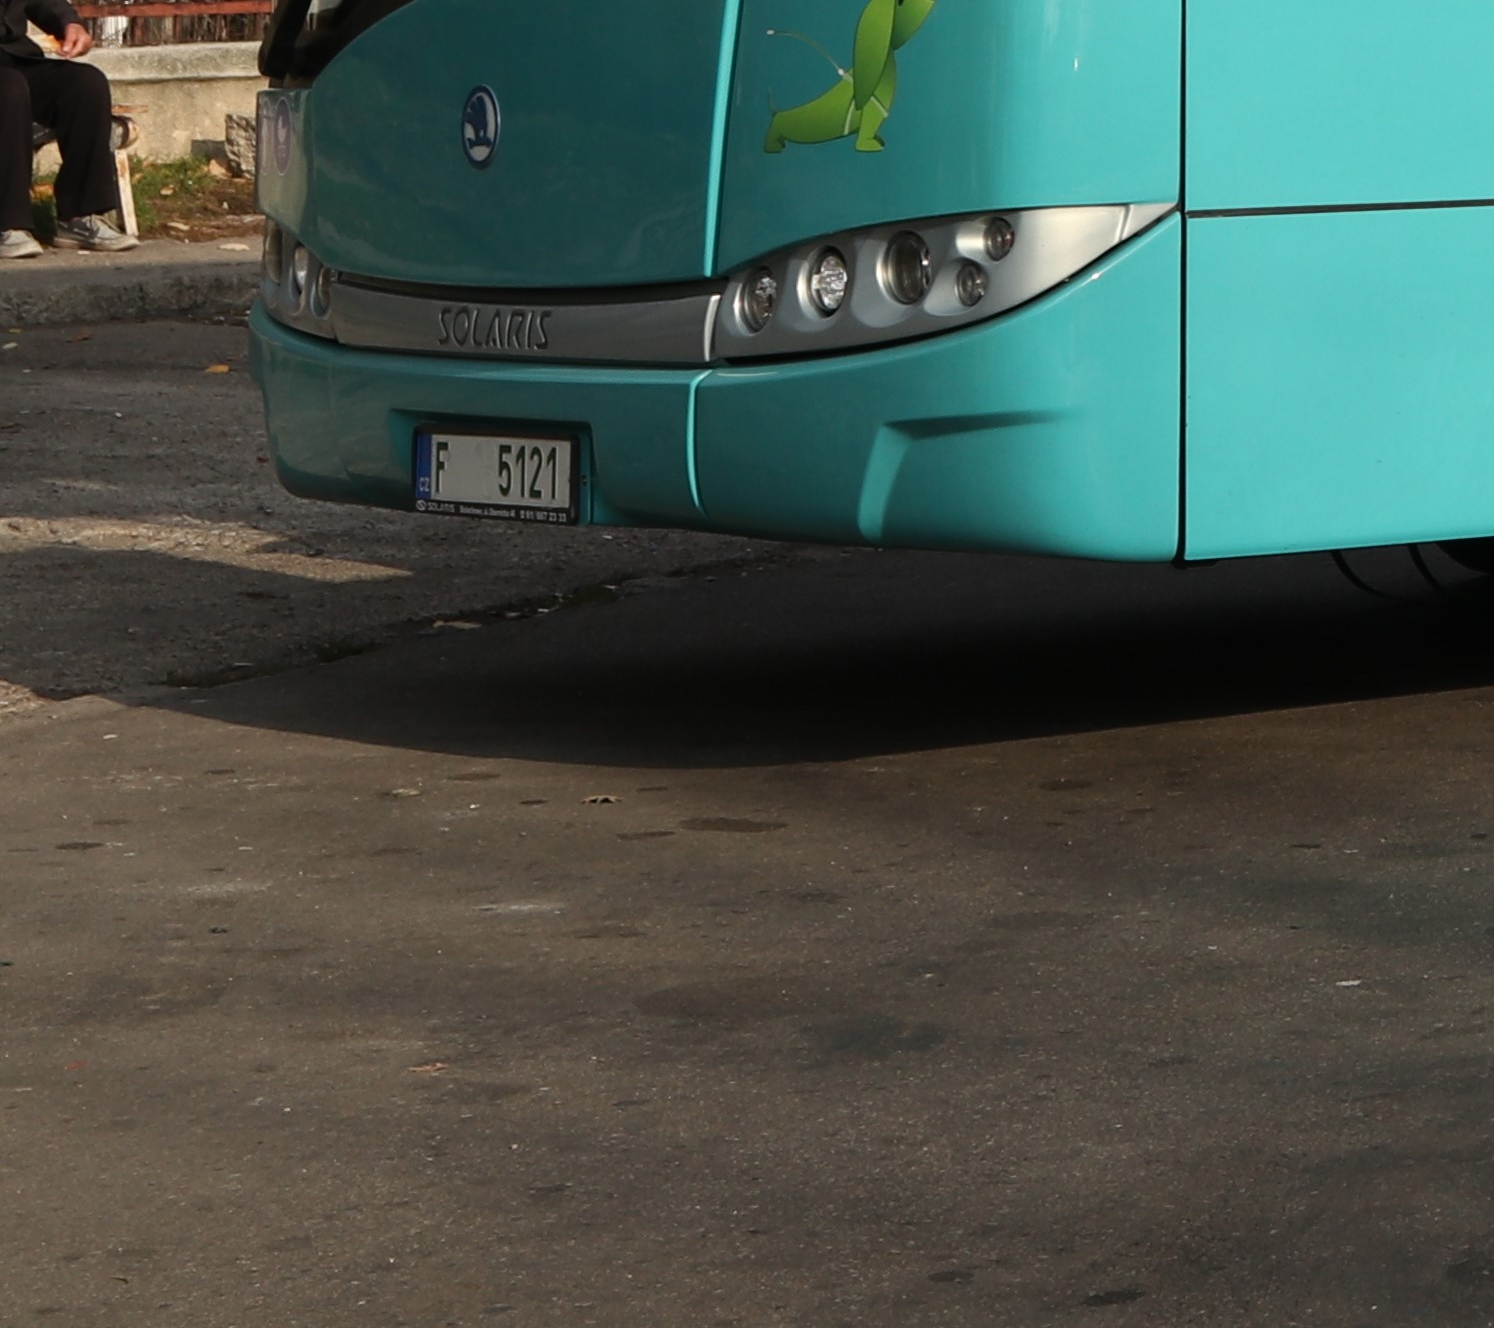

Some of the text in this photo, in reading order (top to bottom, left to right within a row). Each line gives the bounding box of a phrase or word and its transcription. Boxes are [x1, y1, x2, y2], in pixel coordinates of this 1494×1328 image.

[438, 306, 551, 350] SOLARIS
[436, 441, 557, 500] F 5121
